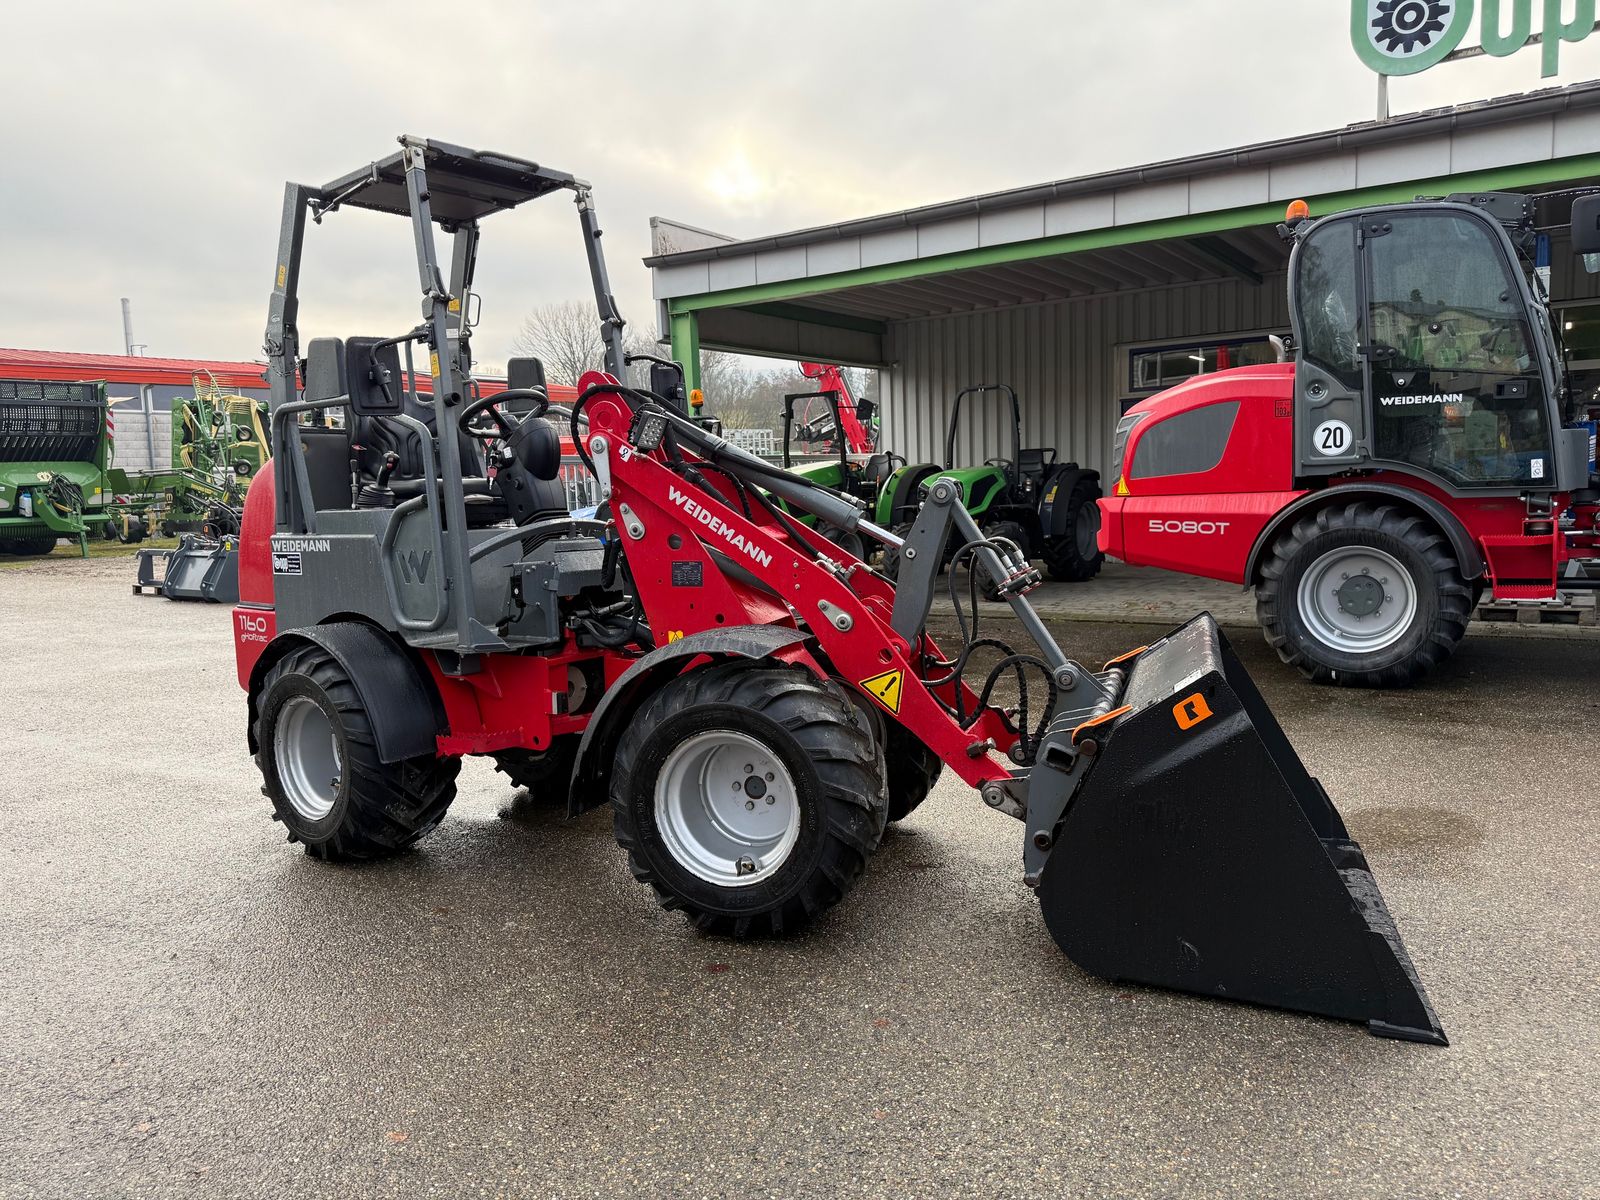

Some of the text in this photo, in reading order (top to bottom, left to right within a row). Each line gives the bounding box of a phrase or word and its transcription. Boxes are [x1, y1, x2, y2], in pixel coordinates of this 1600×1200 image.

[1380, 394, 1463, 406] WEIDEMANN
[1321, 427, 1344, 449] 20
[668, 484, 773, 568] WEIDEMANN
[1149, 520, 1230, 535] 5080T
[271, 540, 331, 552] WEIDEMANN
[238, 614, 267, 632] 1160
